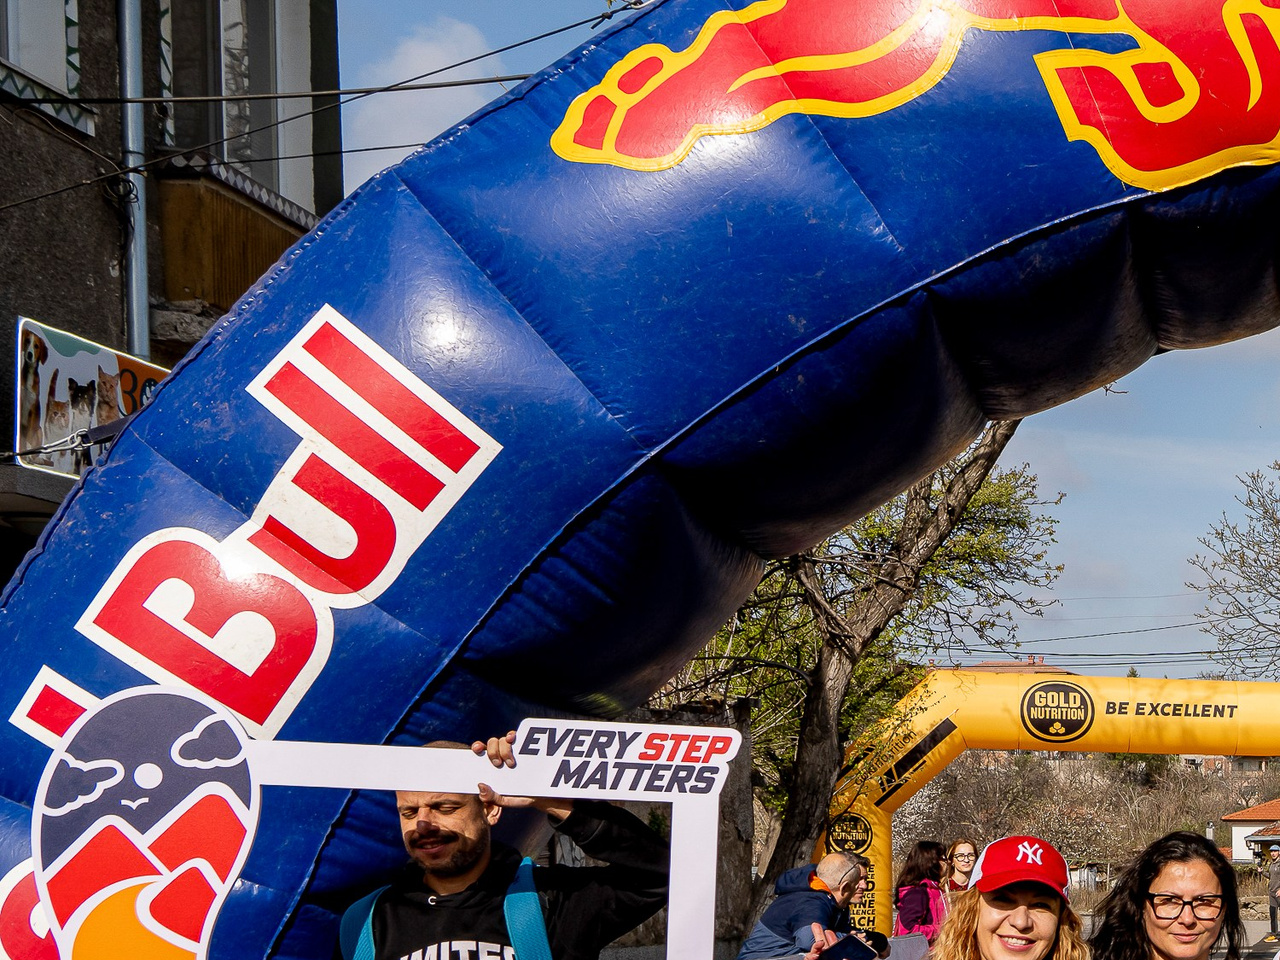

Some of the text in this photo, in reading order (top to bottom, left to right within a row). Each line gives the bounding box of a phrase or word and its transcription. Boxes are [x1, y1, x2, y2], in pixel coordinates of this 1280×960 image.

[84, 312, 492, 734] Bull
[1034, 691, 1081, 708] GOLD
[1105, 701, 1238, 718] BE EXCELLENT
[1030, 706, 1085, 720] NUTRITION
[518, 726, 733, 764] EVERY STEP
[550, 759, 720, 794] MATTERS
[1016, 841, 1044, 865] NY
